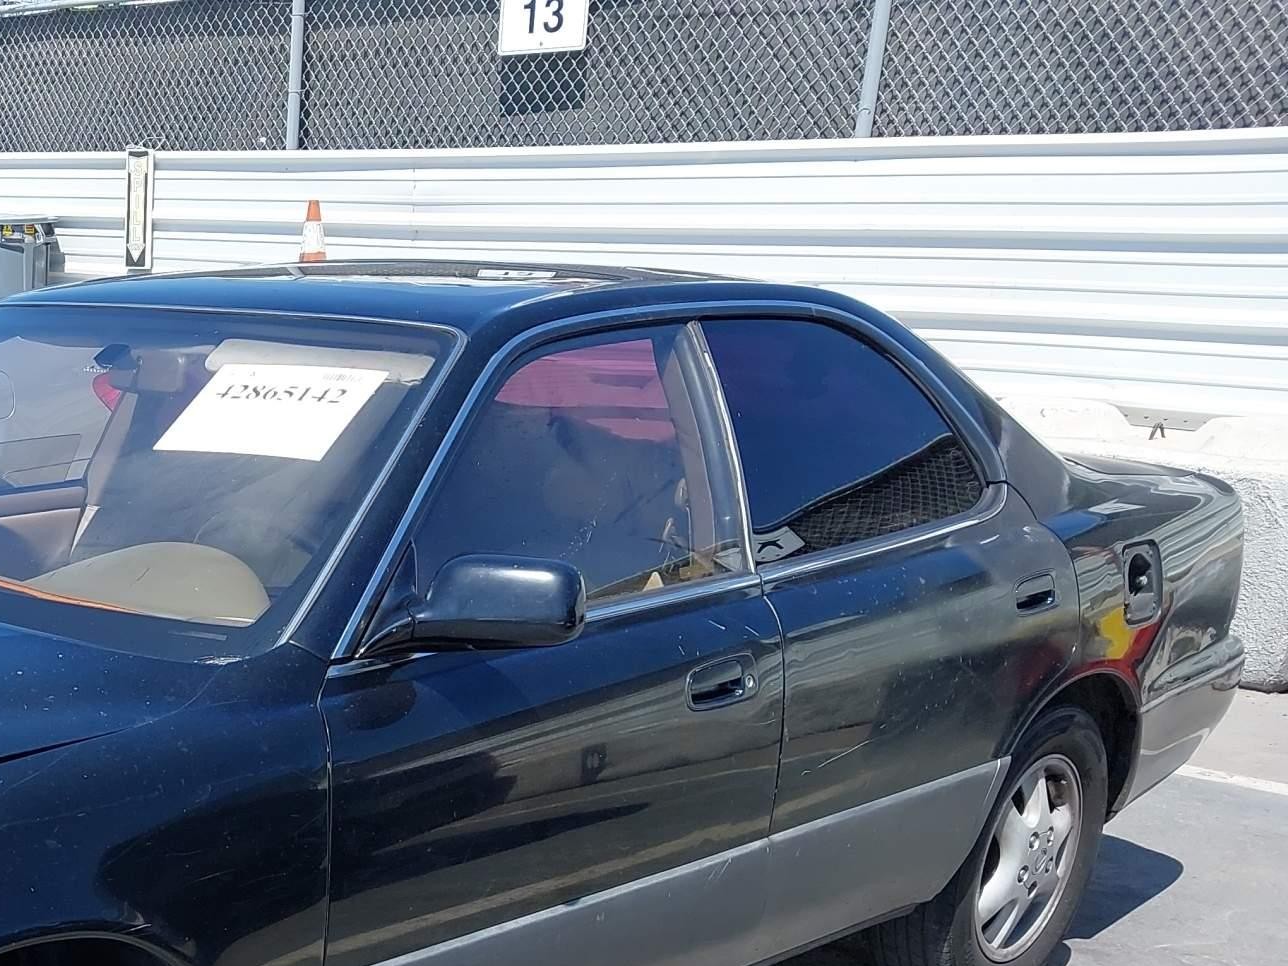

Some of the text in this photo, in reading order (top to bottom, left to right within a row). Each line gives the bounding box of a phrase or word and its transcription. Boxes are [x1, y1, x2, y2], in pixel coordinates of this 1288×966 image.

[523, 0, 564, 34] 13
[131, 160, 143, 242] SPILL
[216, 384, 348, 404] 42865142
